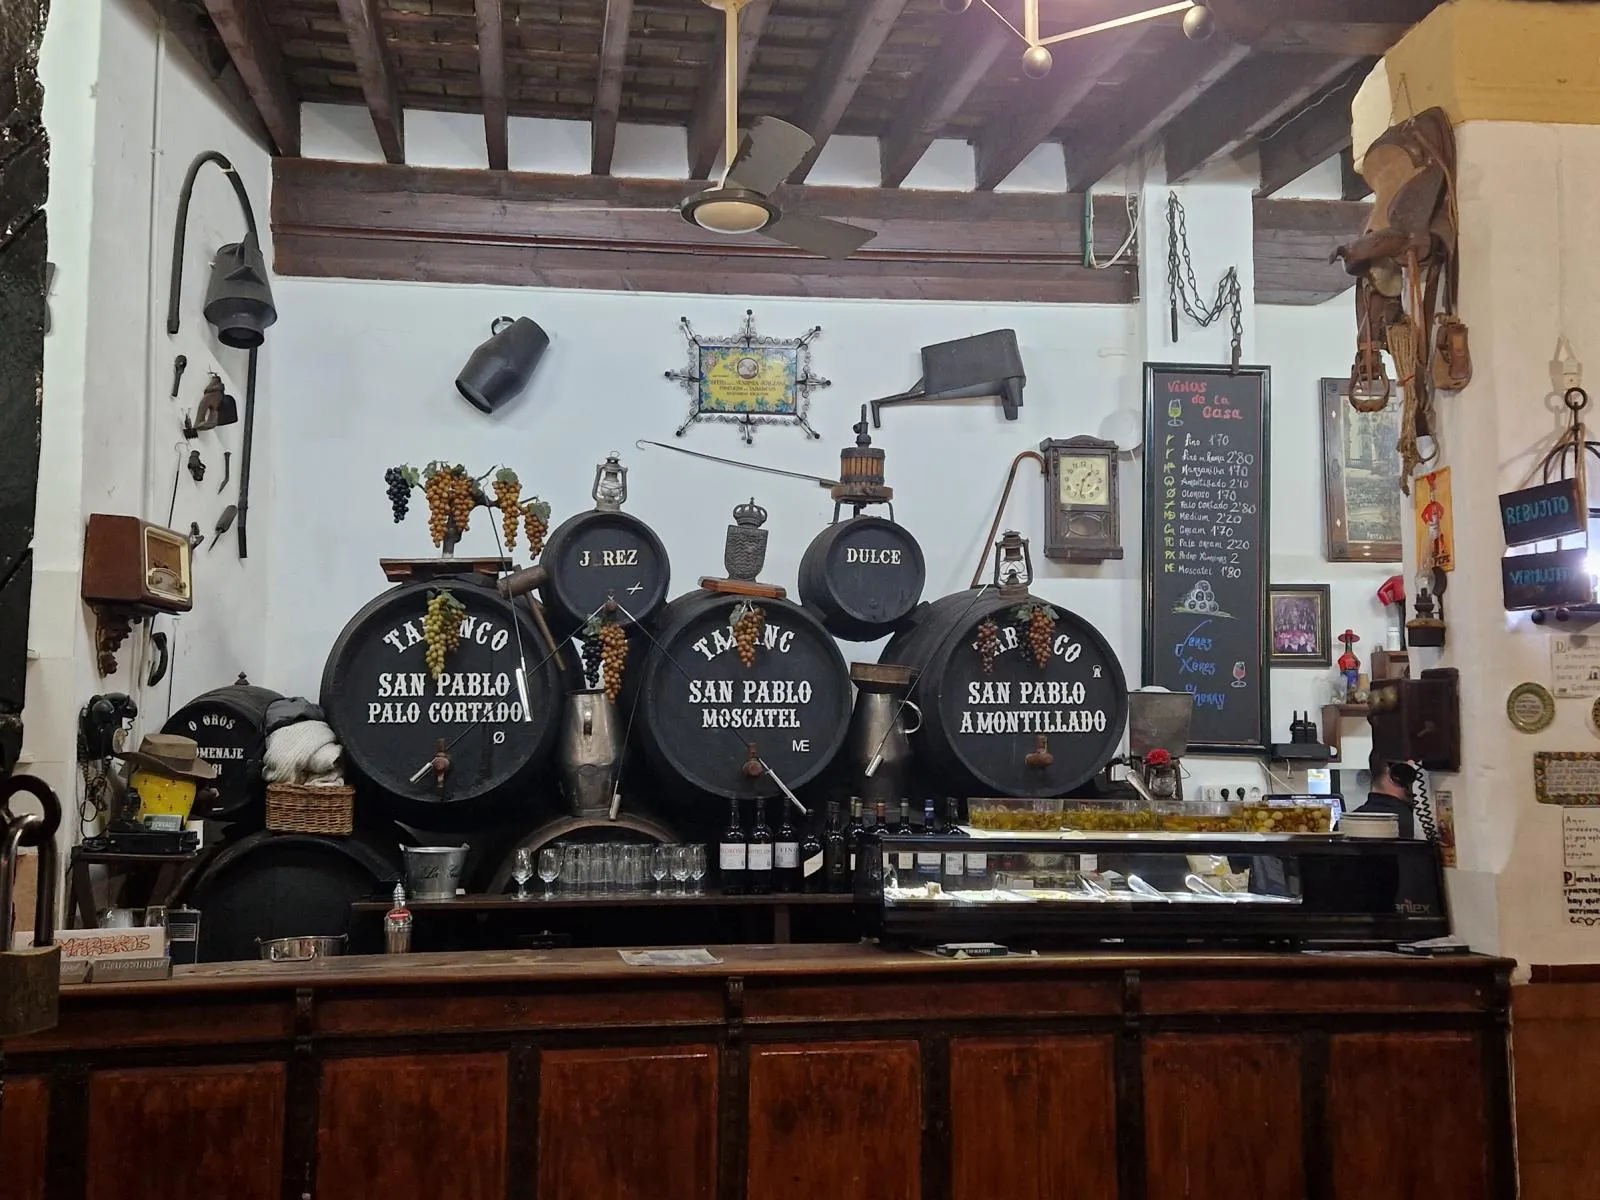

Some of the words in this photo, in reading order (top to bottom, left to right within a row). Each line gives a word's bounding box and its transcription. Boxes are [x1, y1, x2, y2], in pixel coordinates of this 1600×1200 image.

[1191, 394, 1206, 405] de
[1203, 406, 1243, 419] Casa
[1226, 450, 1254, 465] 2'80
[1181, 464, 1225, 477] Manzanilla
[1182, 489, 1210, 500] Oloroso
[1217, 489, 1237, 501] 1'70
[1230, 502, 1256, 514] 2'80
[1506, 495, 1569, 525] REBUJITO
[1216, 512, 1242, 524] 2'20
[1180, 525, 1206, 536] Cream
[1211, 525, 1234, 537] 1'70
[1179, 538, 1195, 548] Pale
[1226, 539, 1250, 550] 2'20
[580, 549, 639, 566] JREZ
[846, 547, 902, 565] DULCE
[1230, 552, 1240, 564] 2
[1178, 565, 1213, 576] Moscatel
[1221, 566, 1241, 579] 1'80
[382, 614, 510, 654] TANCO
[378, 672, 427, 697] SAN
[436, 672, 511, 697] PABLO
[688, 679, 735, 704] SAN
[742, 680, 813, 704] PABLO
[968, 681, 1011, 704] SAN
[1019, 681, 1086, 704] PABLO
[367, 701, 421, 724] PALO
[428, 701, 523, 724] CORTADO
[701, 708, 801, 728] MOSCATEL
[960, 709, 1107, 734] AMONTILLADO
[195, 746, 244, 760] MENAJE
